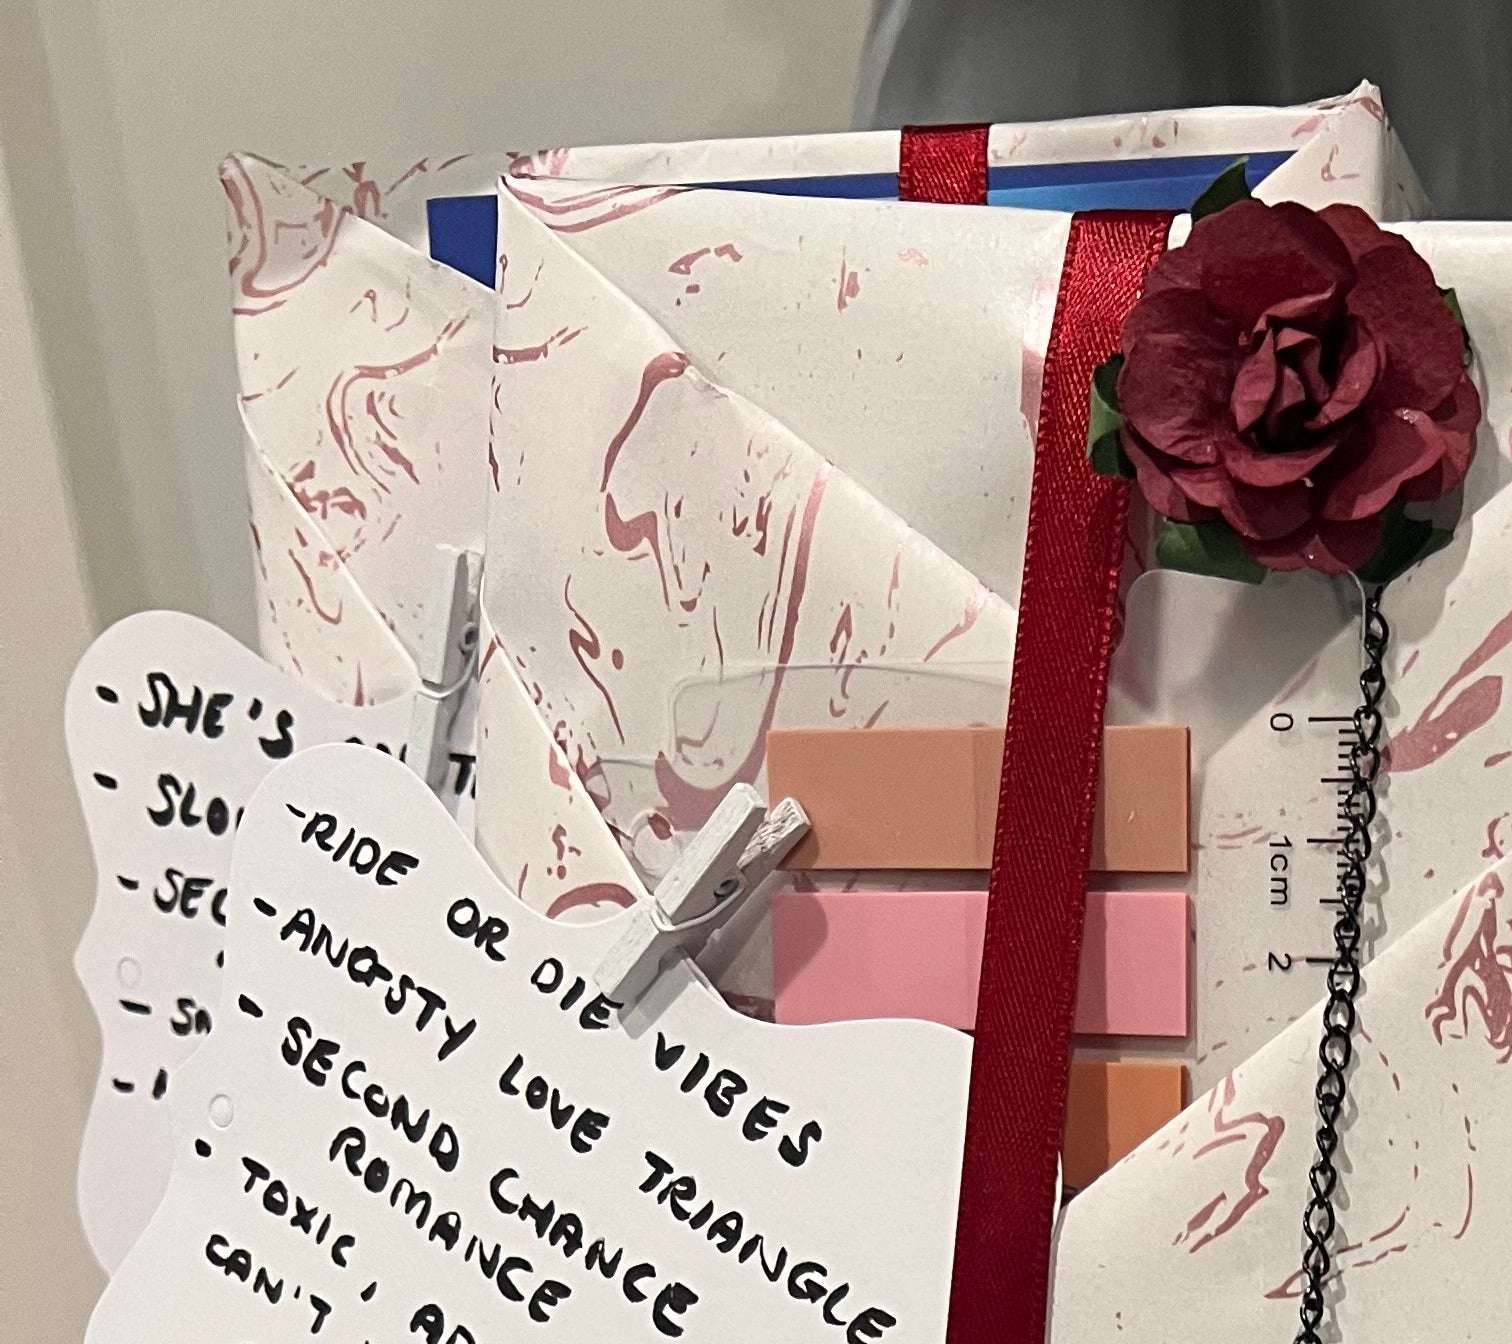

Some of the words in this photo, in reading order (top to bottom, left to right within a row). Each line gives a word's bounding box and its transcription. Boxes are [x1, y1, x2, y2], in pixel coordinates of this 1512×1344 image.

[138, 671, 294, 759] SHE'S
[1270, 712, 1293, 732] 0
[1268, 952, 1292, 972] 2
[446, 898, 509, 963] OR
[531, 957, 625, 1033] DIE
[655, 1031, 822, 1168] VIBES
[499, 1054, 611, 1154] LOVE
[280, 1016, 460, 1172] SECOND
[489, 1167, 700, 1338] CHANCE
[329, 1127, 573, 1324] ROMANCE
[204, 1233, 332, 1334] CAN'T
